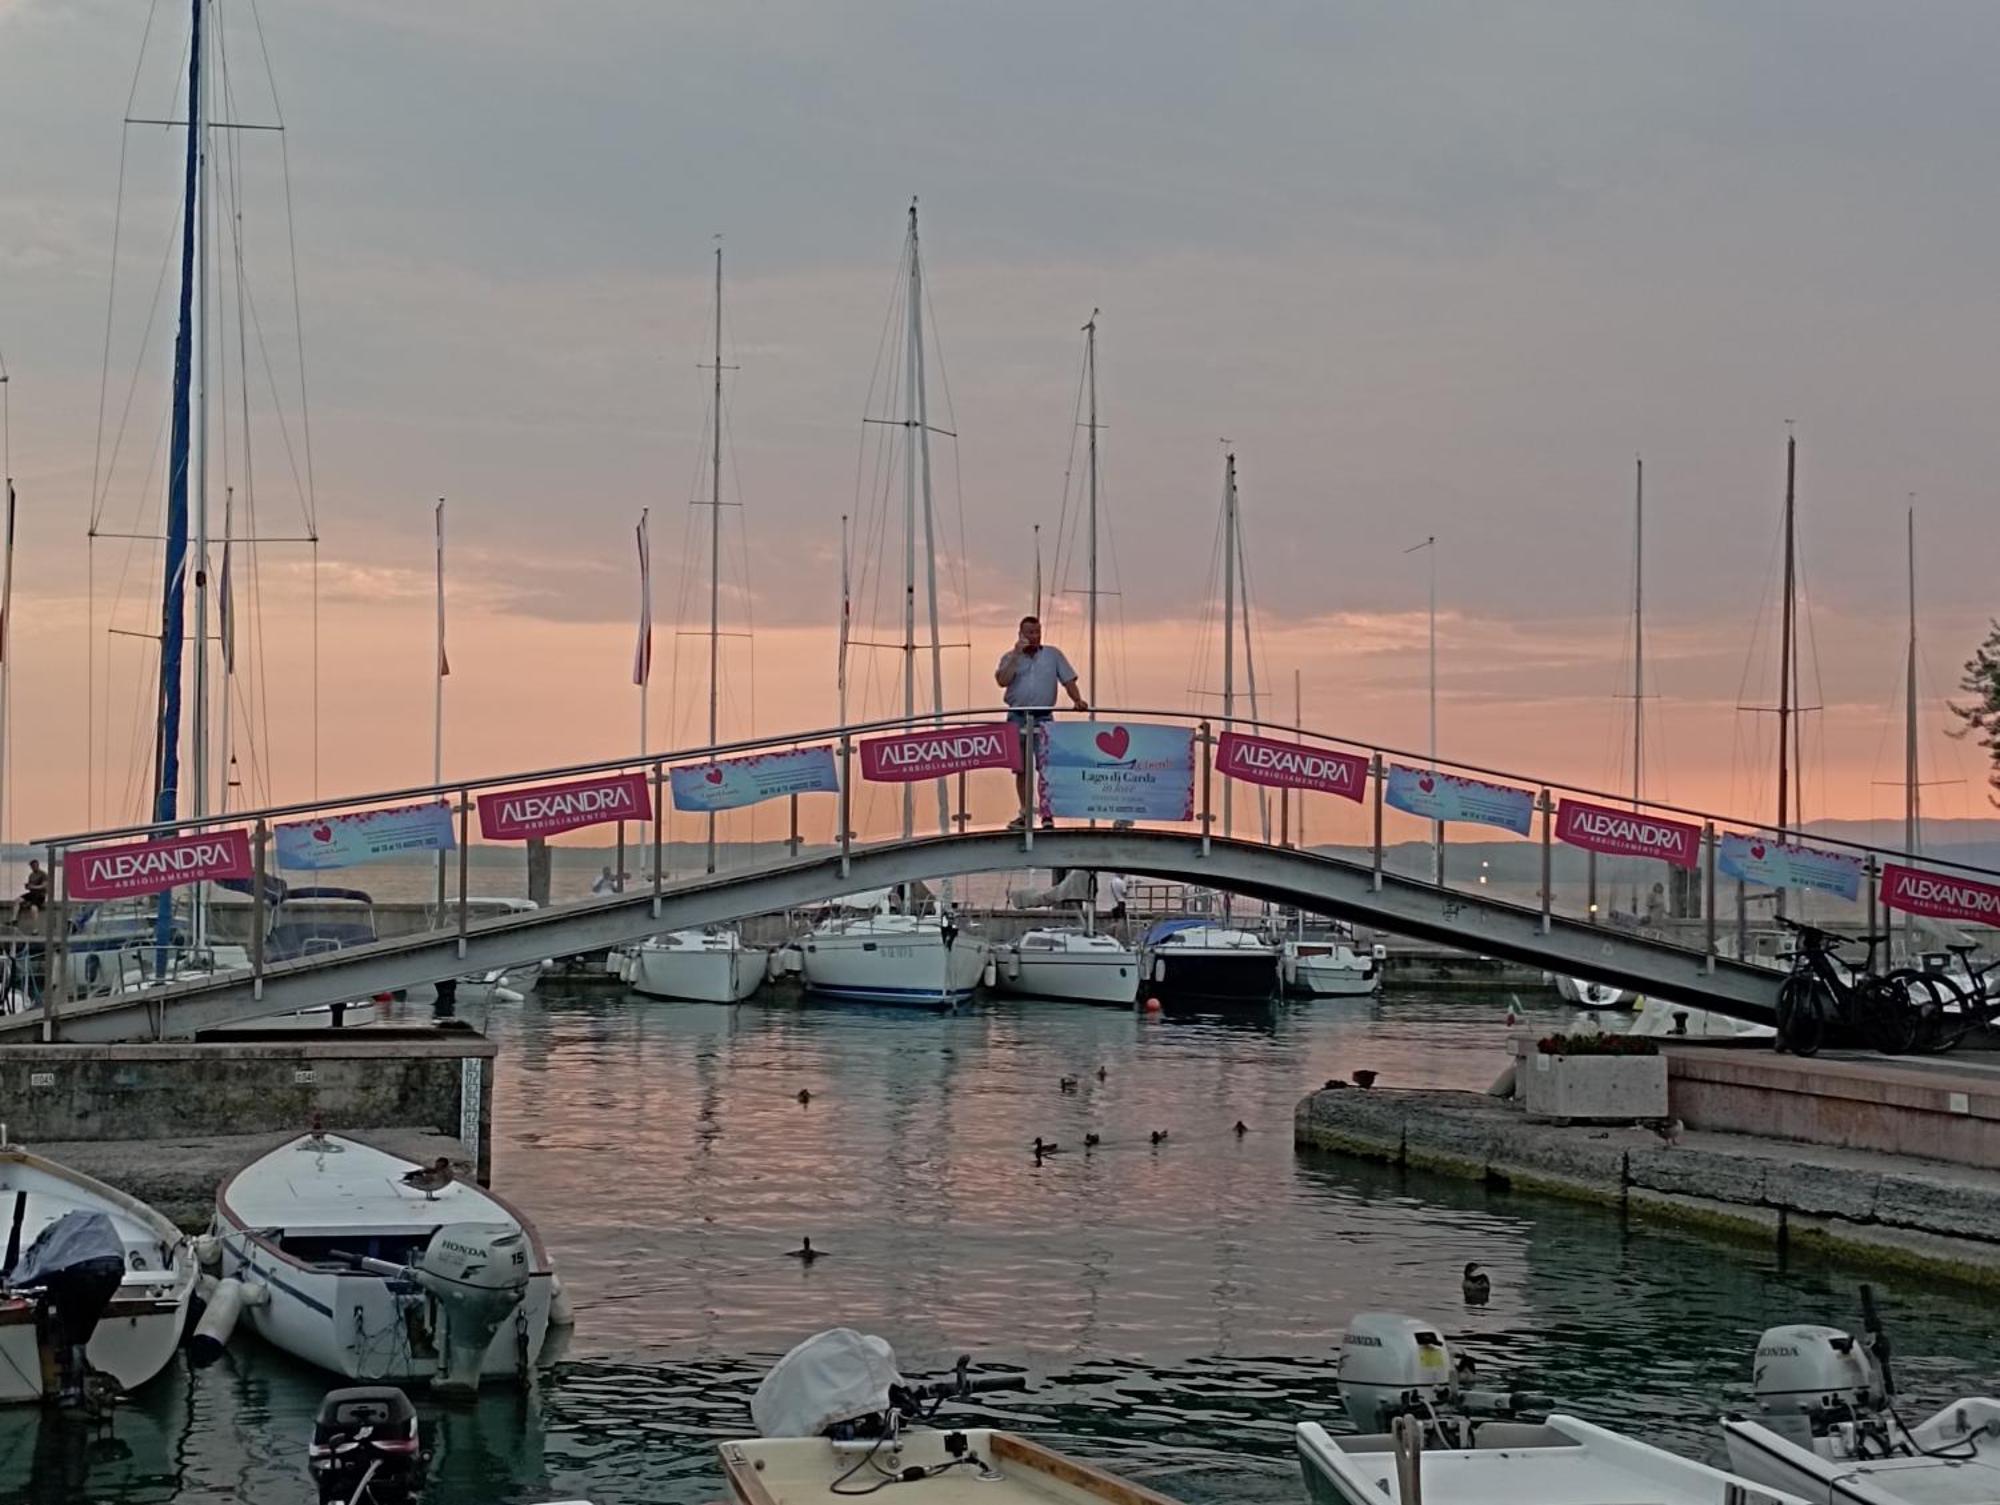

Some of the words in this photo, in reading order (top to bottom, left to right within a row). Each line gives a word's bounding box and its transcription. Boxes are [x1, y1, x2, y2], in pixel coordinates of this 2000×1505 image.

[881, 735, 1003, 767] ALEXANDRA
[1234, 744, 1349, 784] ALEXANDRA
[1081, 770, 1109, 785] Lago
[1123, 771, 1157, 784] Garda
[501, 786, 631, 825] ALEXANDRA
[1573, 812, 1683, 851] ALEXANDRA
[90, 843, 230, 883] ALEXANDRA
[114, 869, 205, 889] ABBIGLIAMENTO
[1897, 876, 2000, 916] ALEXANDRA
[442, 1240, 487, 1258] HONDA
[511, 1251, 525, 1266] 15
